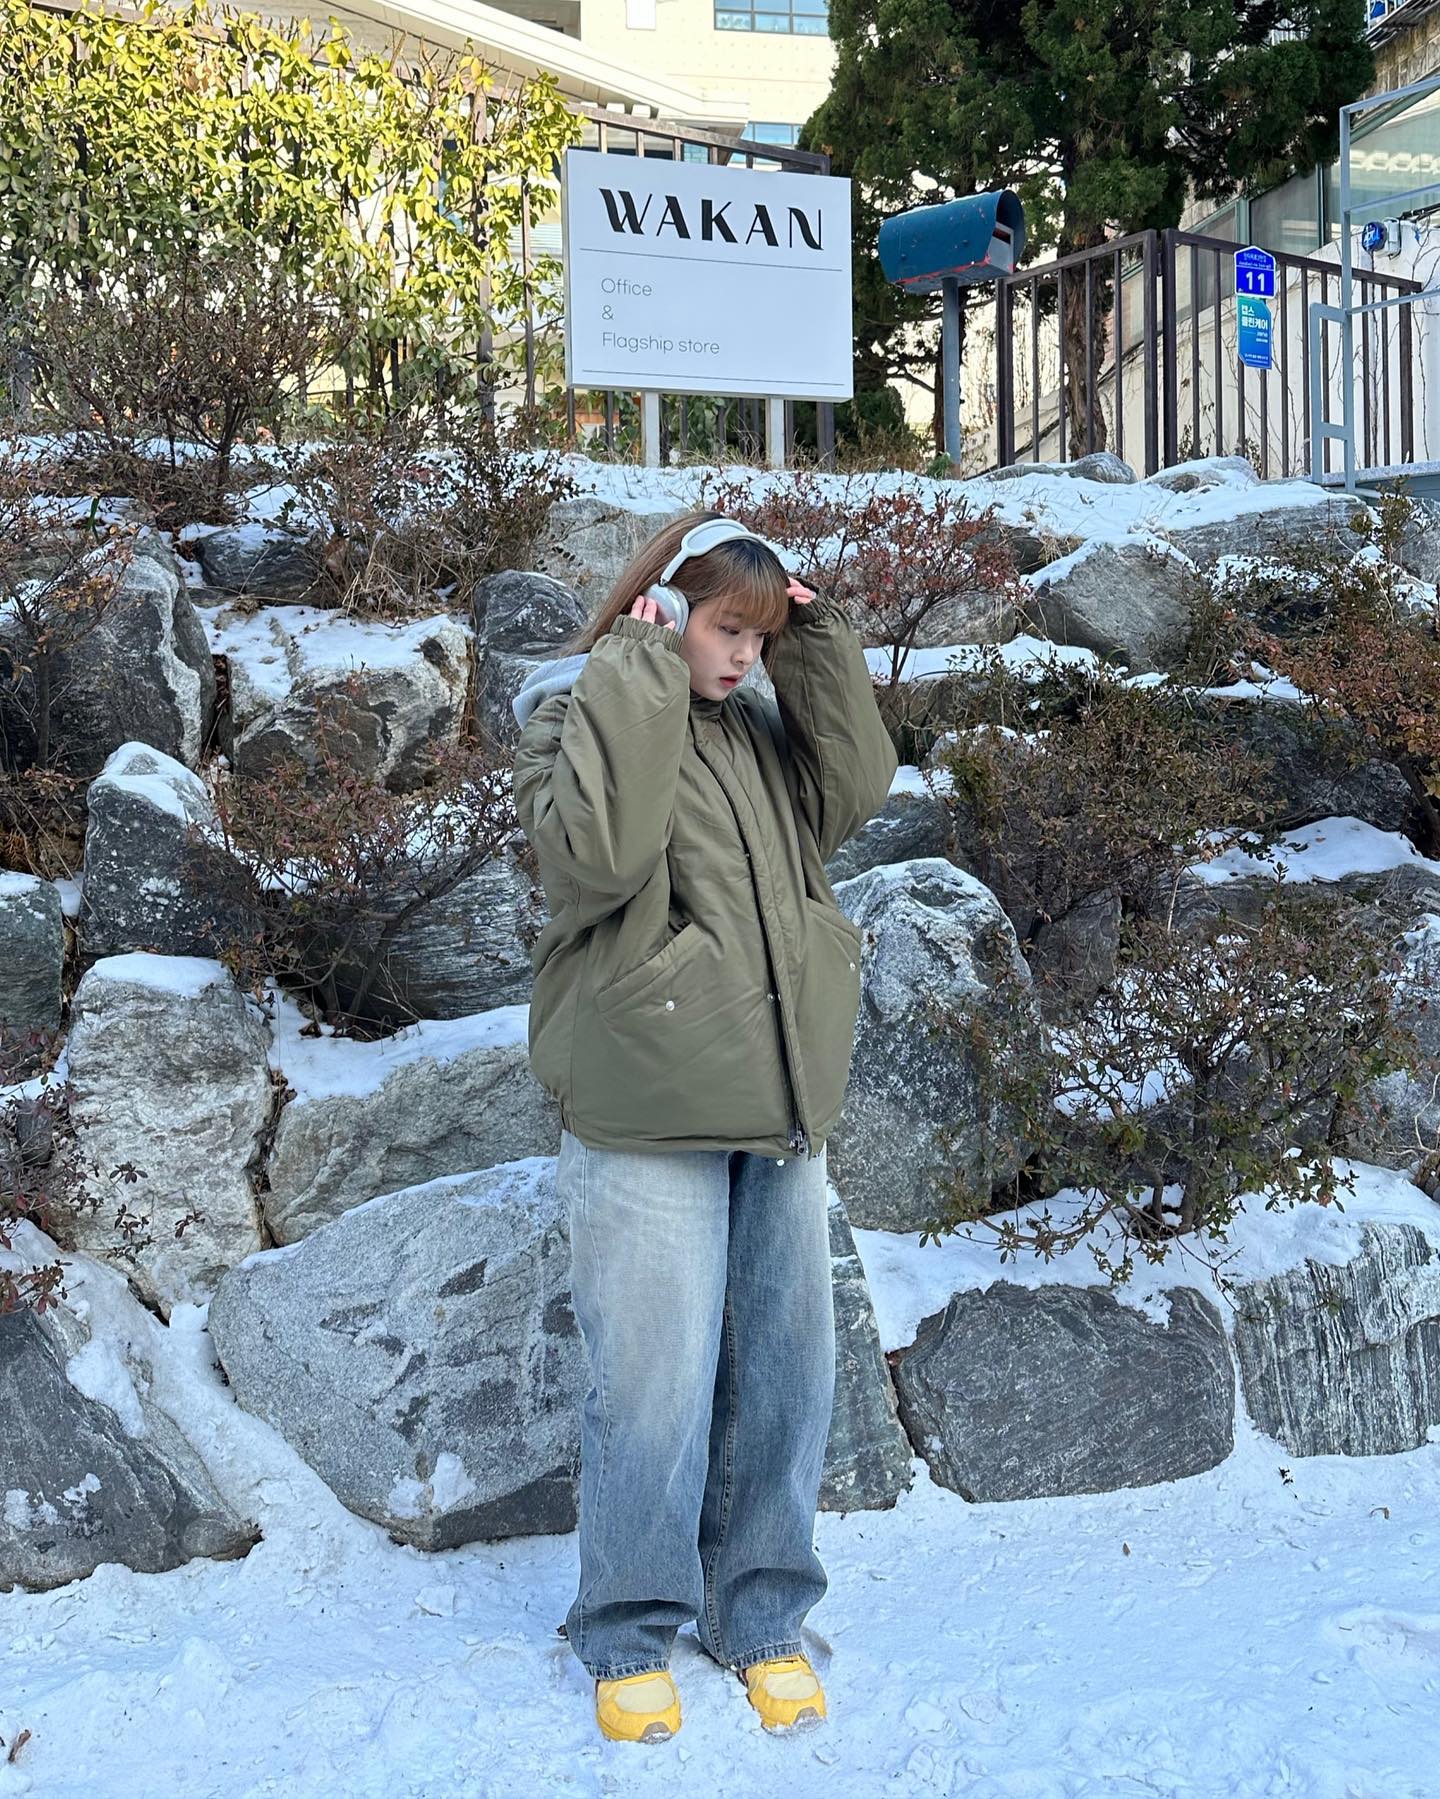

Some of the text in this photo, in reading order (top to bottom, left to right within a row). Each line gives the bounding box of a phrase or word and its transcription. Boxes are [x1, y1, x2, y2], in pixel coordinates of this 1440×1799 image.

[598, 187, 824, 250] WAKAN
[601, 278, 652, 296] Office
[1246, 271, 1265, 291] 11
[601, 304, 614, 320] &
[602, 332, 720, 354] Flagship store
